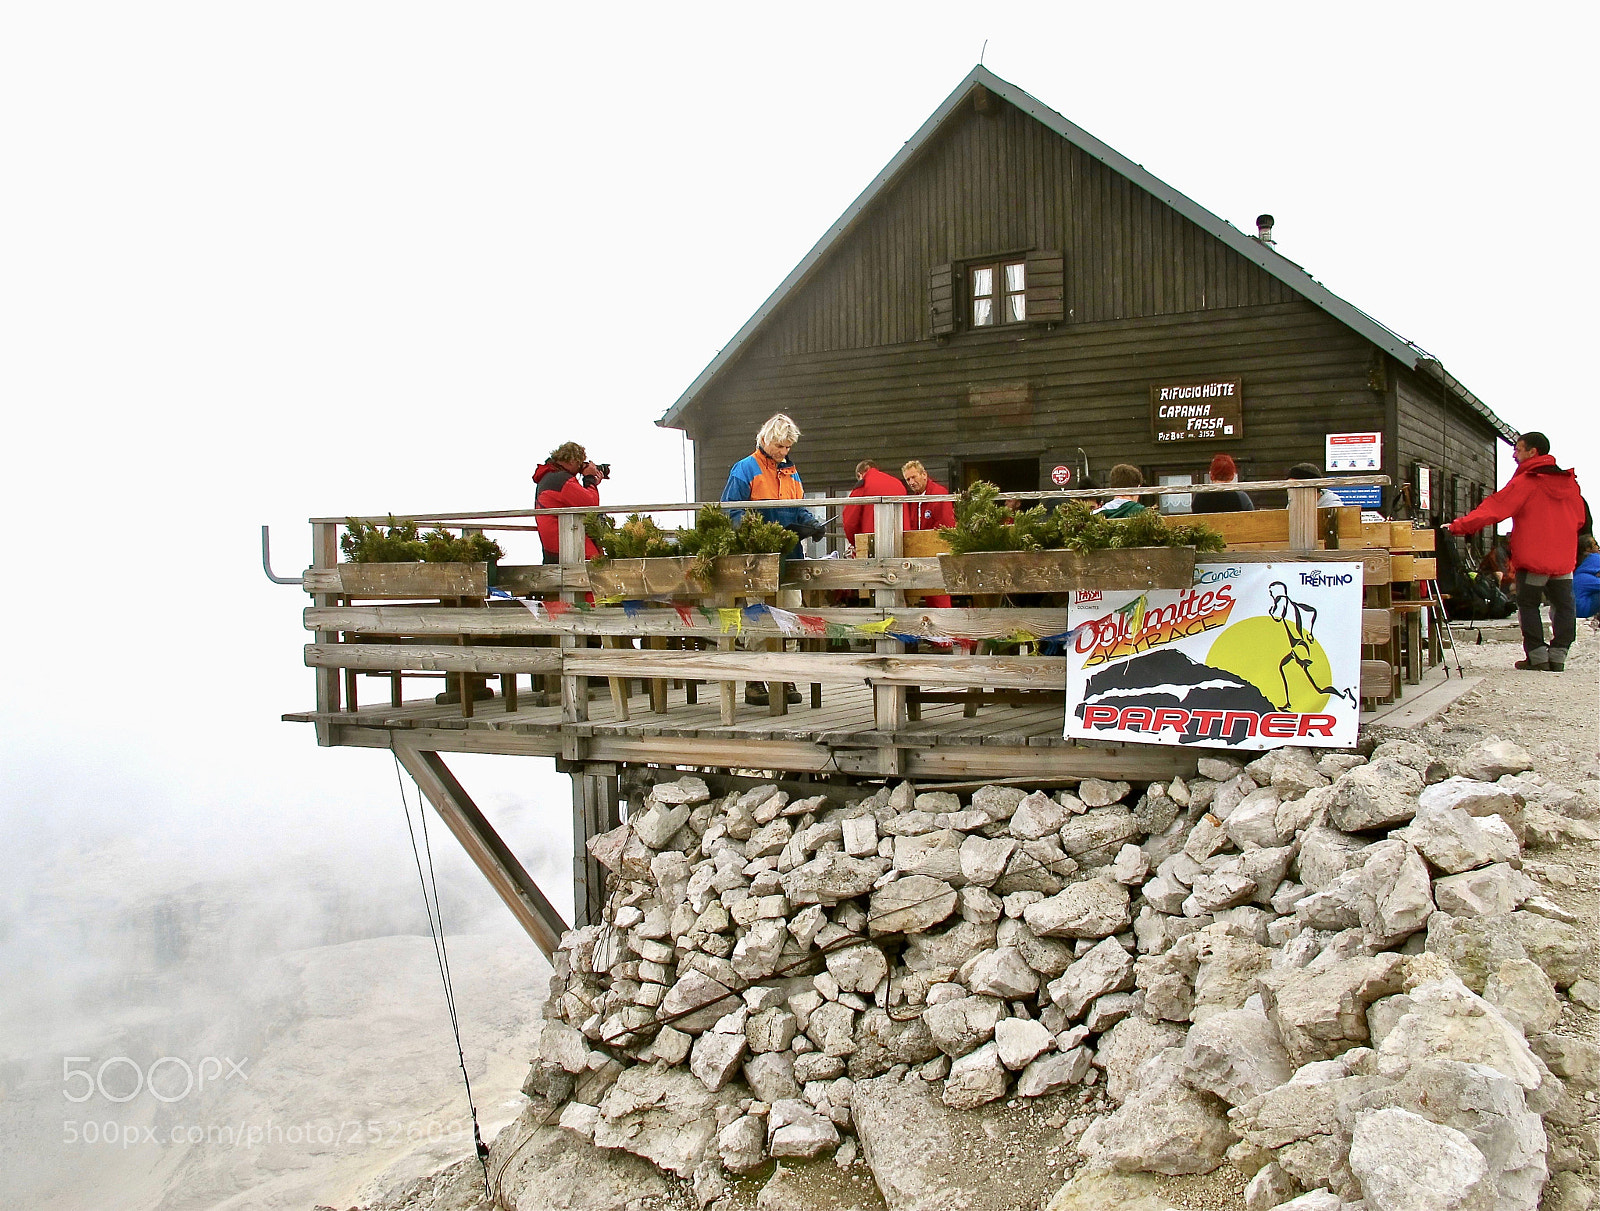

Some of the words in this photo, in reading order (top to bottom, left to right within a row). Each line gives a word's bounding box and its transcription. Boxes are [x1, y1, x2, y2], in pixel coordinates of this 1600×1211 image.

[1160, 386, 1201, 401] RIFUGIO
[1159, 404, 1211, 418] CAPANNA
[1186, 417, 1224, 431] FASSA
[1198, 430, 1216, 438] 3152
[1200, 566, 1242, 585] Canazei
[1299, 572, 1353, 588] TRENTINO
[1086, 615, 1218, 667] SKYRACE
[1083, 705, 1338, 738] PARTNER
